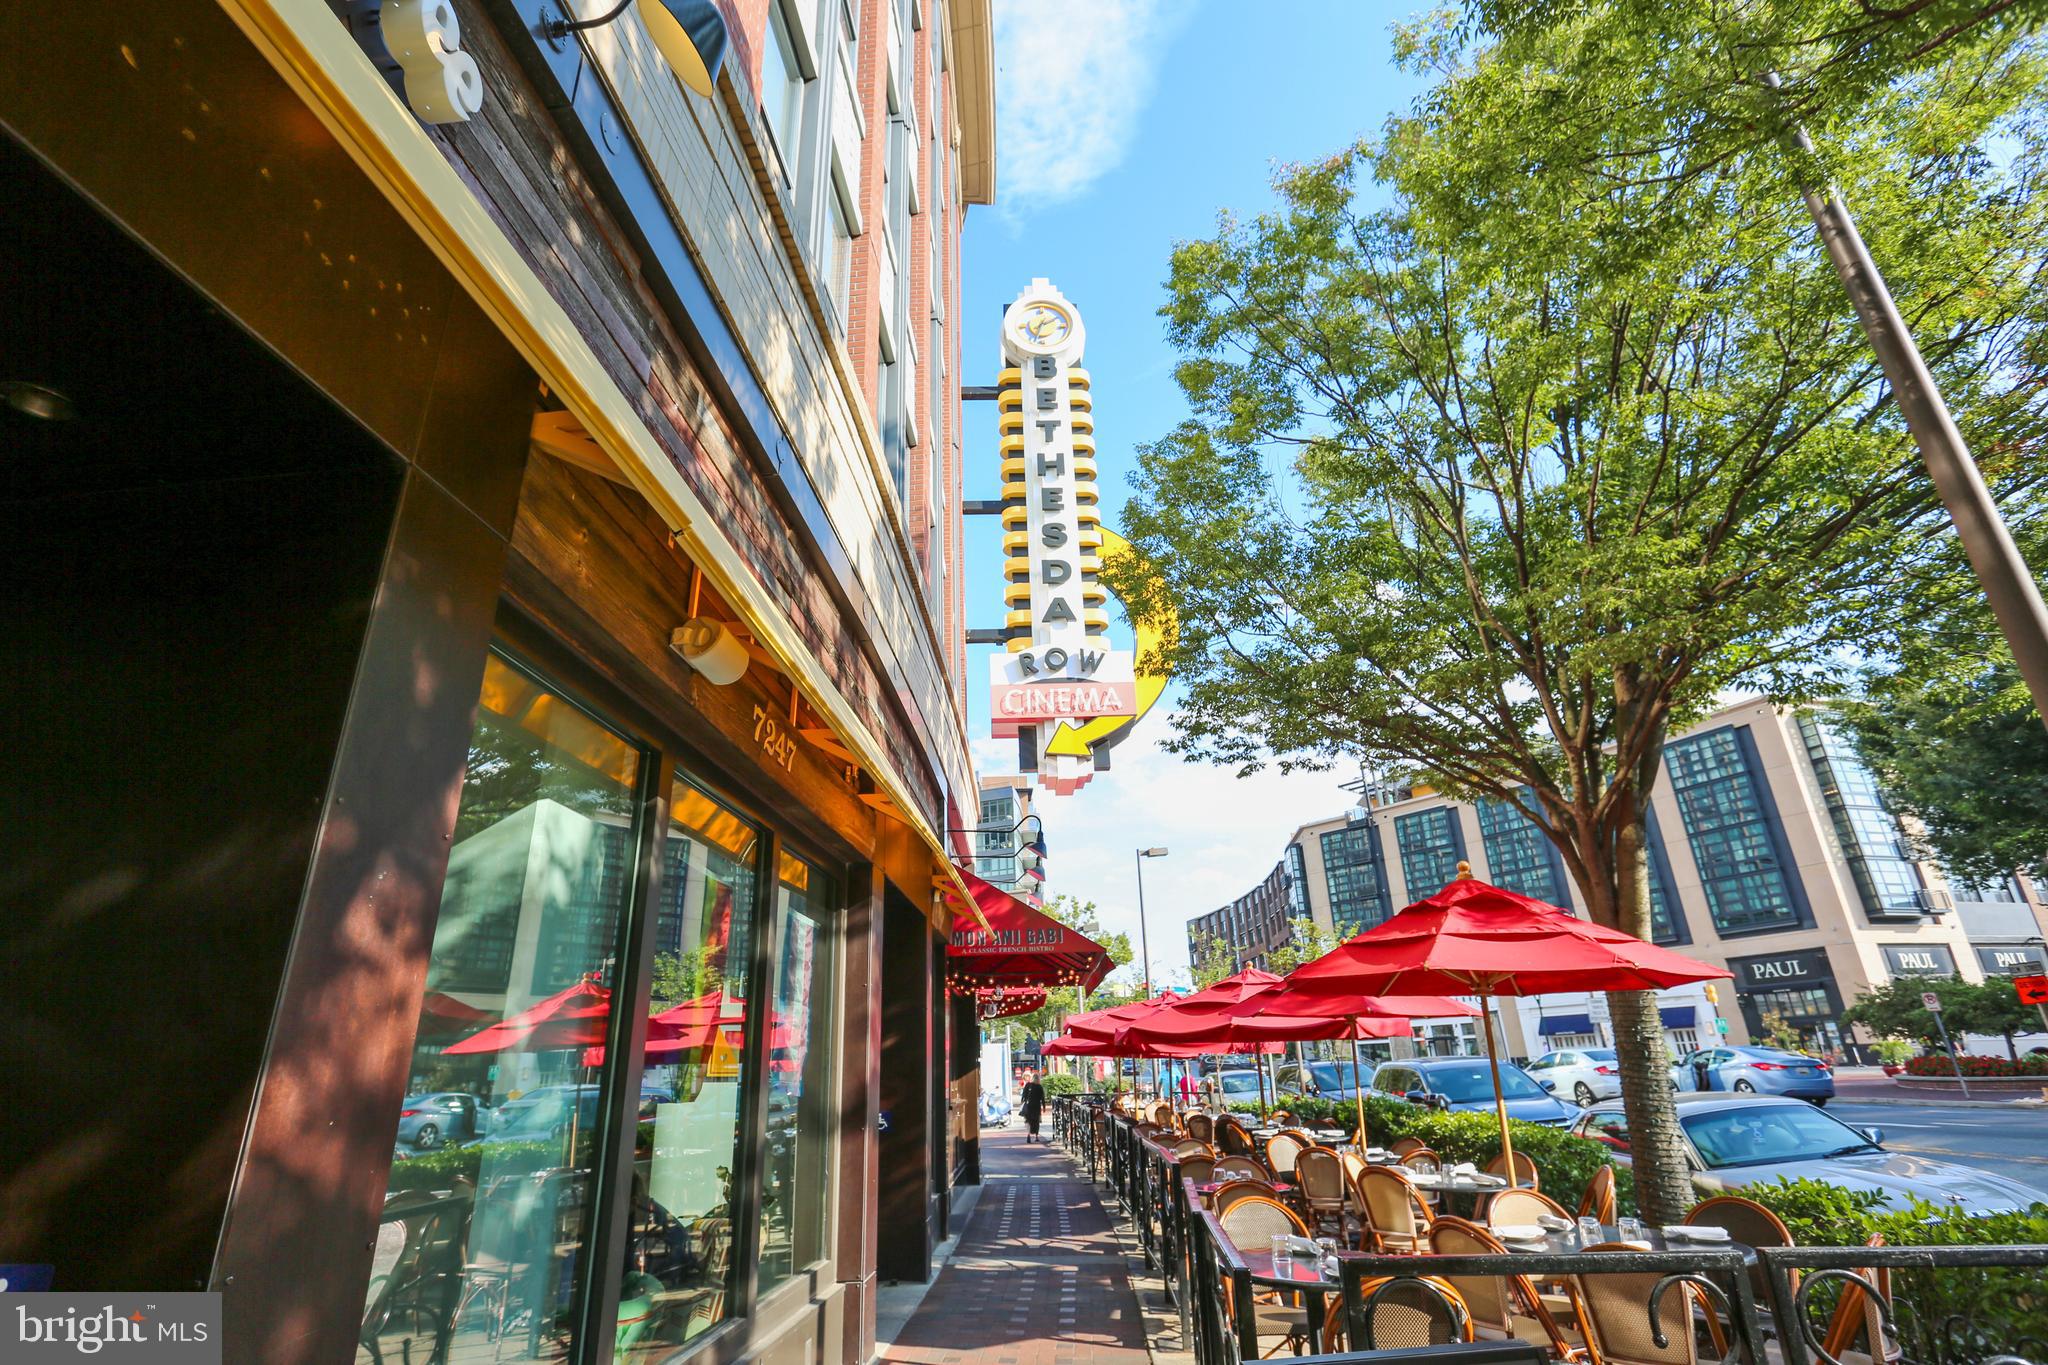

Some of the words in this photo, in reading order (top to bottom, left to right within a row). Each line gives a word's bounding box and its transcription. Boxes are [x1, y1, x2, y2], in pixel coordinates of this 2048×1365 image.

[1034, 357, 1077, 623] BETHESDA
[1019, 648, 1105, 676] ROW
[1003, 687, 1123, 714] CINEMA
[754, 704, 797, 773] 7247
[951, 931, 986, 947] MON
[993, 928, 1021, 945] AMI
[1027, 928, 1064, 945] GABI
[1751, 960, 1807, 979] PAUL
[1897, 952, 1938, 969] PAUL
